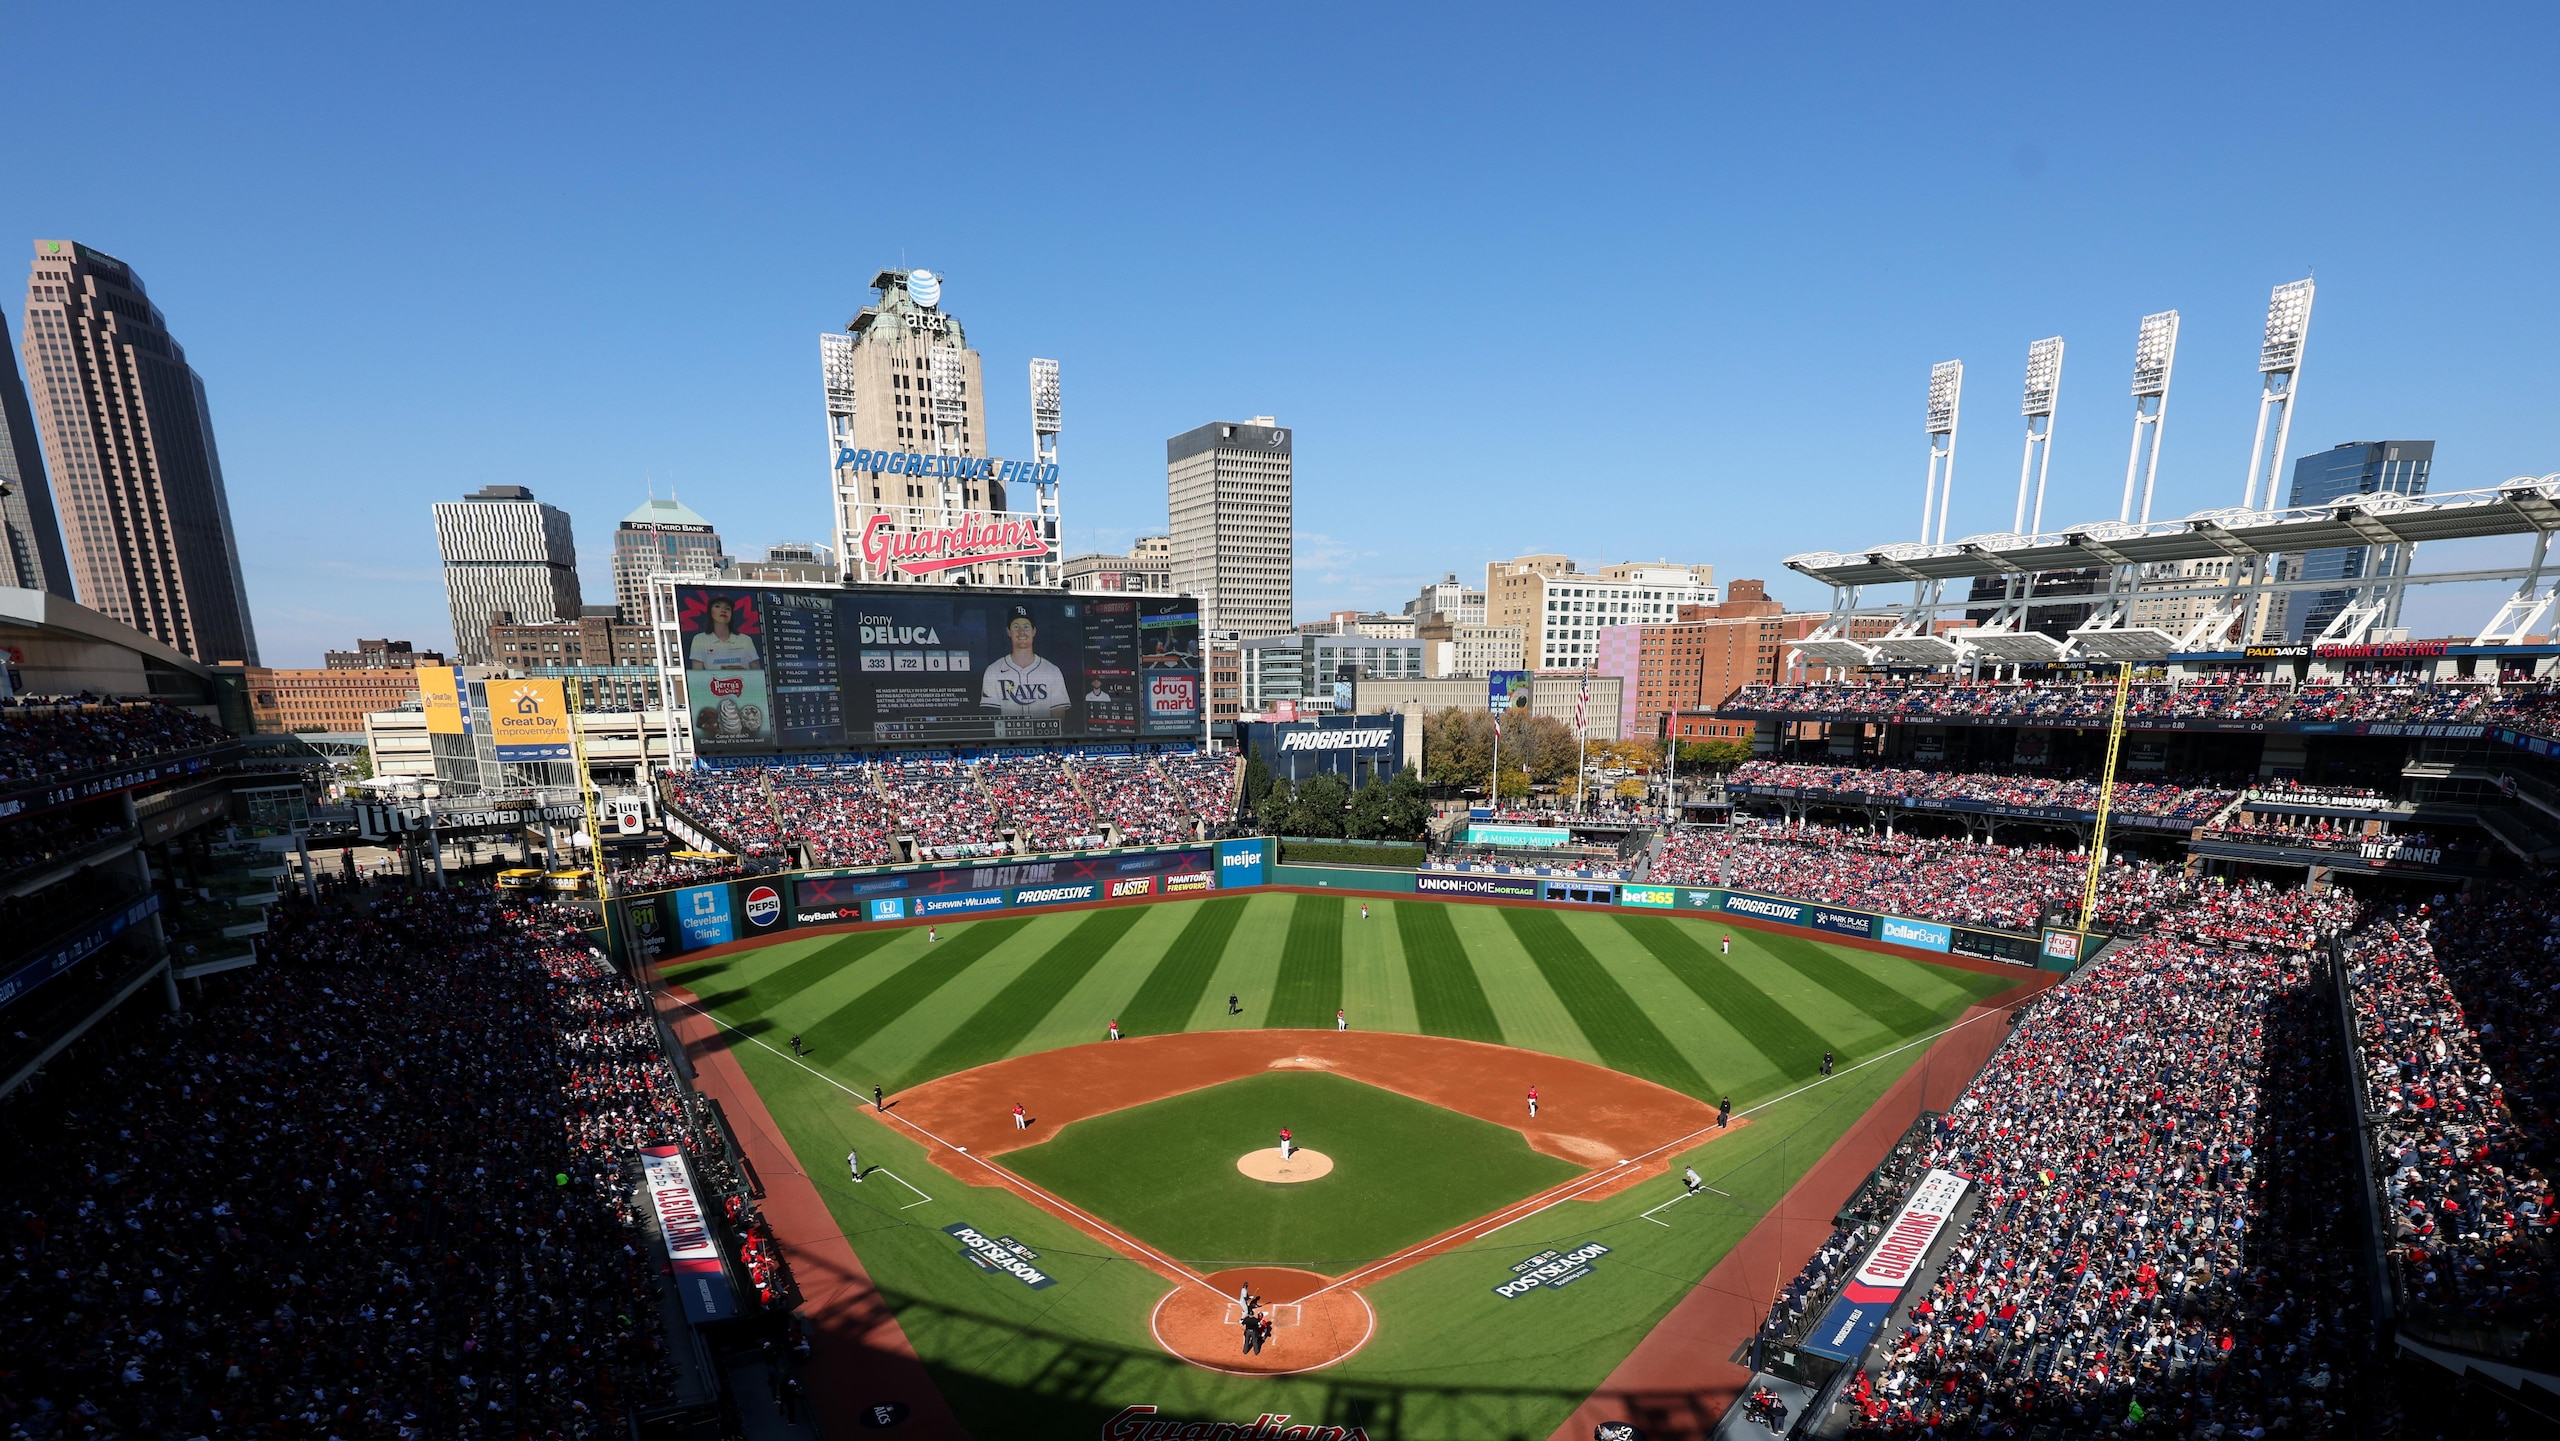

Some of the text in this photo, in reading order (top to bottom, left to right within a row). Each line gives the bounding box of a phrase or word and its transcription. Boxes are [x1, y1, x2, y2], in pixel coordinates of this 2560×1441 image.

[906, 310, 948, 332] at&t
[835, 448, 1059, 485] PROGRESSIVE FIELD
[631, 522, 704, 533] FIFTH THIRD BANK
[861, 512, 1049, 577] Guardians
[858, 612, 893, 627] Jonny
[860, 626, 941, 645] DELUCA
[2315, 641, 2450, 659] PENNANT DISTRICT
[867, 659, 885, 668] .333
[900, 659, 917, 668] .722
[713, 679, 739, 689] Perry's
[1152, 676, 1187, 698] drug
[1001, 678, 1047, 706] RAYS
[1156, 698, 1195, 710] mart
[501, 716, 558, 727] Great Day
[1893, 715, 1900, 723] 32
[496, 727, 566, 738] Improvements
[2250, 723, 2263, 731] 0-0
[2368, 724, 2401, 735] BRING
[2426, 725, 2444, 736] THE
[2445, 725, 2485, 738] HEATER
[1281, 728, 1393, 751] PROGRESSIVE
[900, 750, 951, 759] HONDA
[995, 747, 1045, 756] HONDA
[1084, 743, 1131, 753] HONDA
[717, 756, 778, 766] HONDA
[797, 753, 854, 763] HONDA
[494, 800, 537, 811] PROUDLY
[2262, 792, 2390, 808] FAT HEAD'S BREWERY
[618, 802, 639, 815] Lite
[352, 803, 423, 842] Lite
[450, 806, 580, 828] BREWED IN OHIO
[2160, 818, 2194, 830] BATTER!
[1490, 835, 1527, 844] MEDICAL
[1222, 850, 1262, 868] meijer
[2358, 843, 2441, 864] THE CORNER
[973, 862, 1057, 888] NO FLY ZONE
[1167, 873, 1207, 885] PHANTOM
[1112, 880, 1150, 898] BLASTER
[1167, 881, 1206, 892] FIREWORKS
[1418, 878, 1534, 896] UNIONHOME MORTGAGE
[1550, 882, 1581, 890] LECOM
[1017, 885, 1094, 904] PROGRESSIVE
[1622, 888, 1674, 905] bet365
[749, 900, 778, 913] PEPSI
[927, 897, 1002, 911] SHERWIN-WILLIAMS
[1726, 896, 1800, 920] PROGRESSIVE
[631, 906, 655, 927] 811
[683, 912, 729, 929] Cleveland
[797, 911, 838, 923] KeyBank
[1829, 913, 1869, 927] PARK PLACE
[694, 928, 721, 940] Clinic
[1837, 922, 1868, 932] TECHNOLOGIES
[1884, 922, 1946, 945] DollarBank
[2047, 932, 2073, 951] drug
[2049, 945, 2077, 956] mart
[655, 1187, 709, 1252] CLEVELAND
[1865, 1211, 1942, 1280] GUARDIANS
[953, 1228, 1045, 1285] POSTSEASON
[1496, 1243, 1608, 1299] POSTSEASON
[873, 1405, 892, 1425] ALCS
